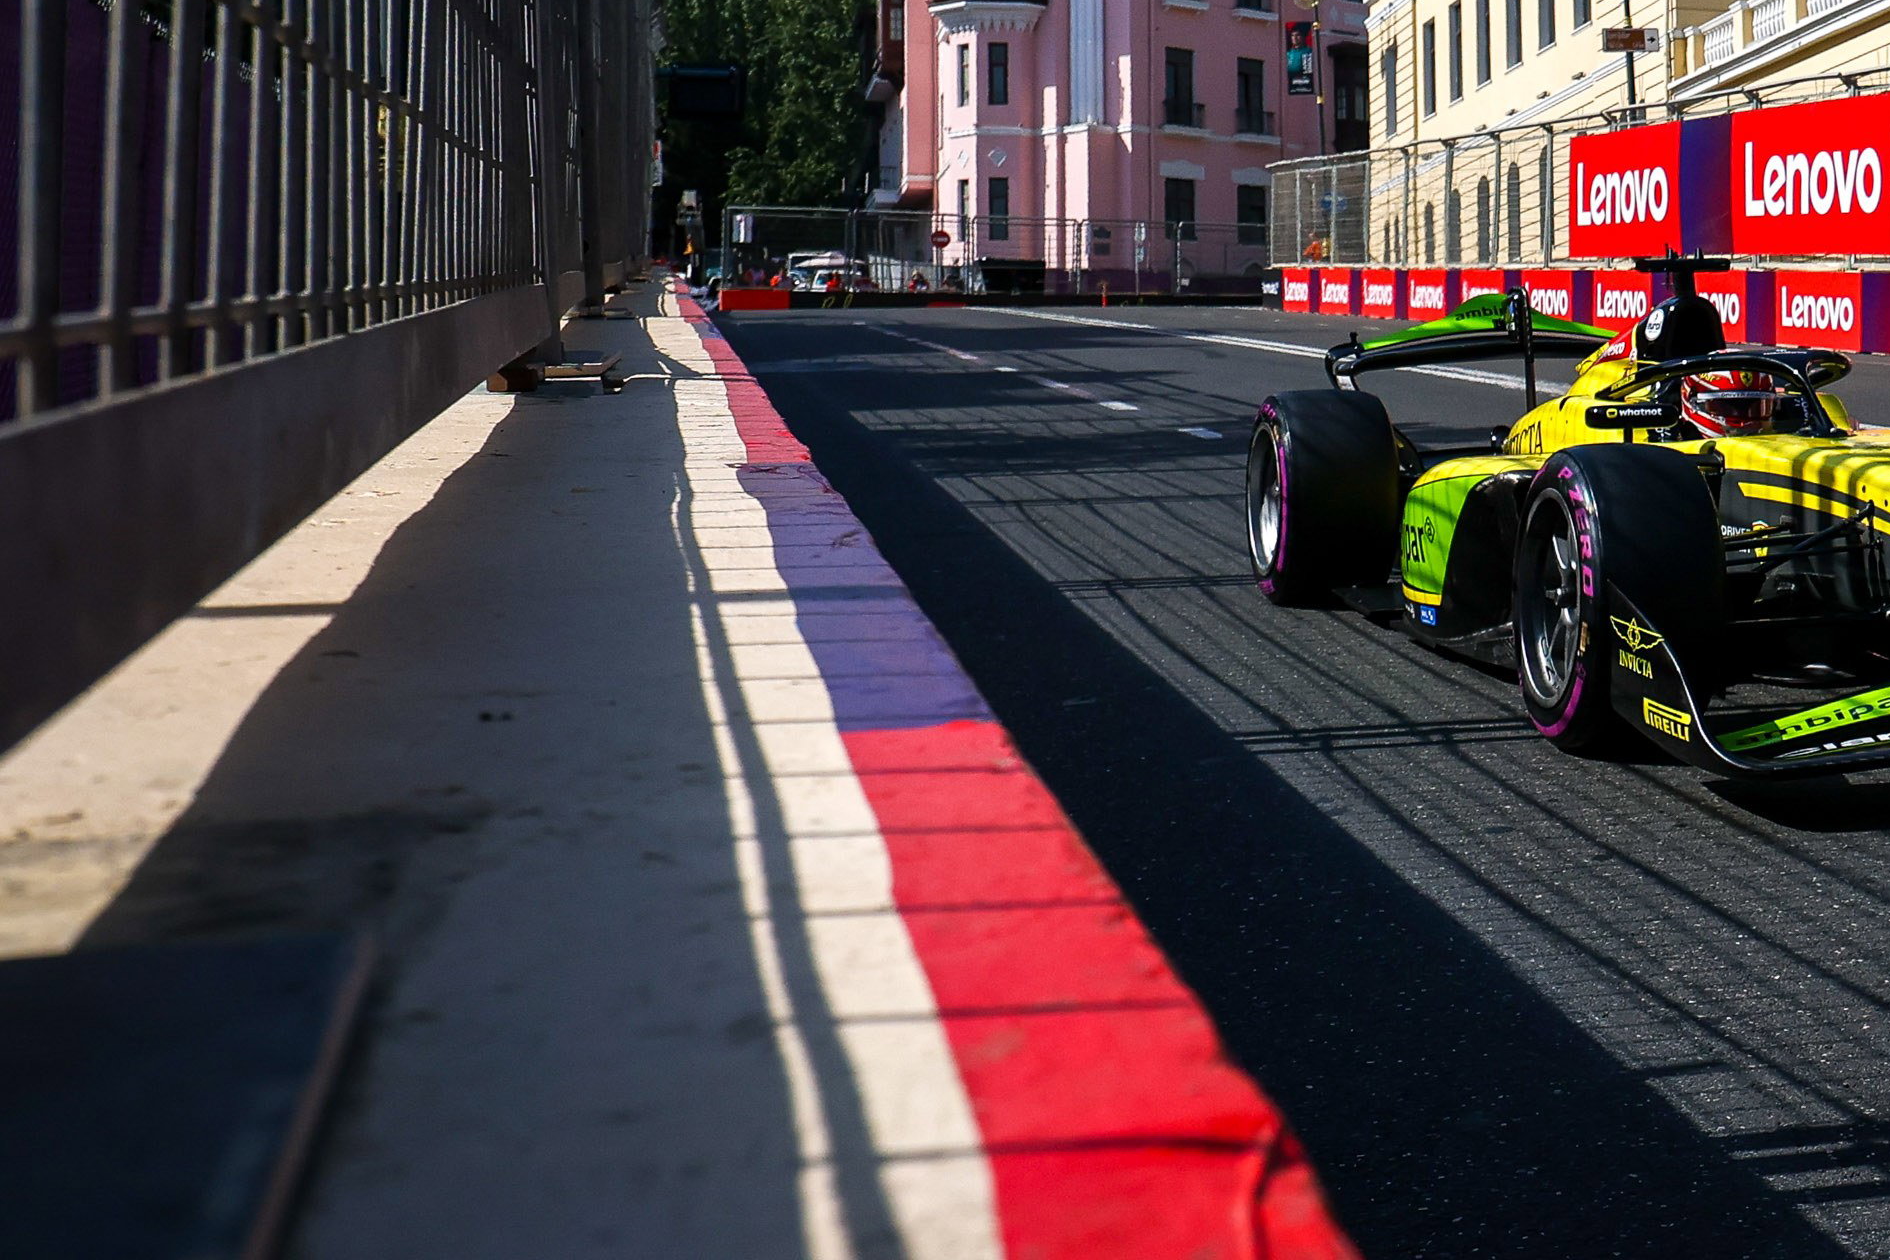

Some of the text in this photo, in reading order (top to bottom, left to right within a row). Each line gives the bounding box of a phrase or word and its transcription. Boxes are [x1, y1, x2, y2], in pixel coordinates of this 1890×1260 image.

[1577, 162, 1669, 226] Lenovo
[1745, 141, 1882, 217] Lenovo
[1410, 280, 1444, 310] Lenovo
[1596, 283, 1647, 319] Lenovo
[1781, 285, 1854, 332] Lenovo
[1619, 407, 1663, 418] whatnot
[1567, 484, 1595, 598] ZERO
[1618, 648, 1653, 680] INVICTA
[1642, 697, 1692, 742] PIRELLI
